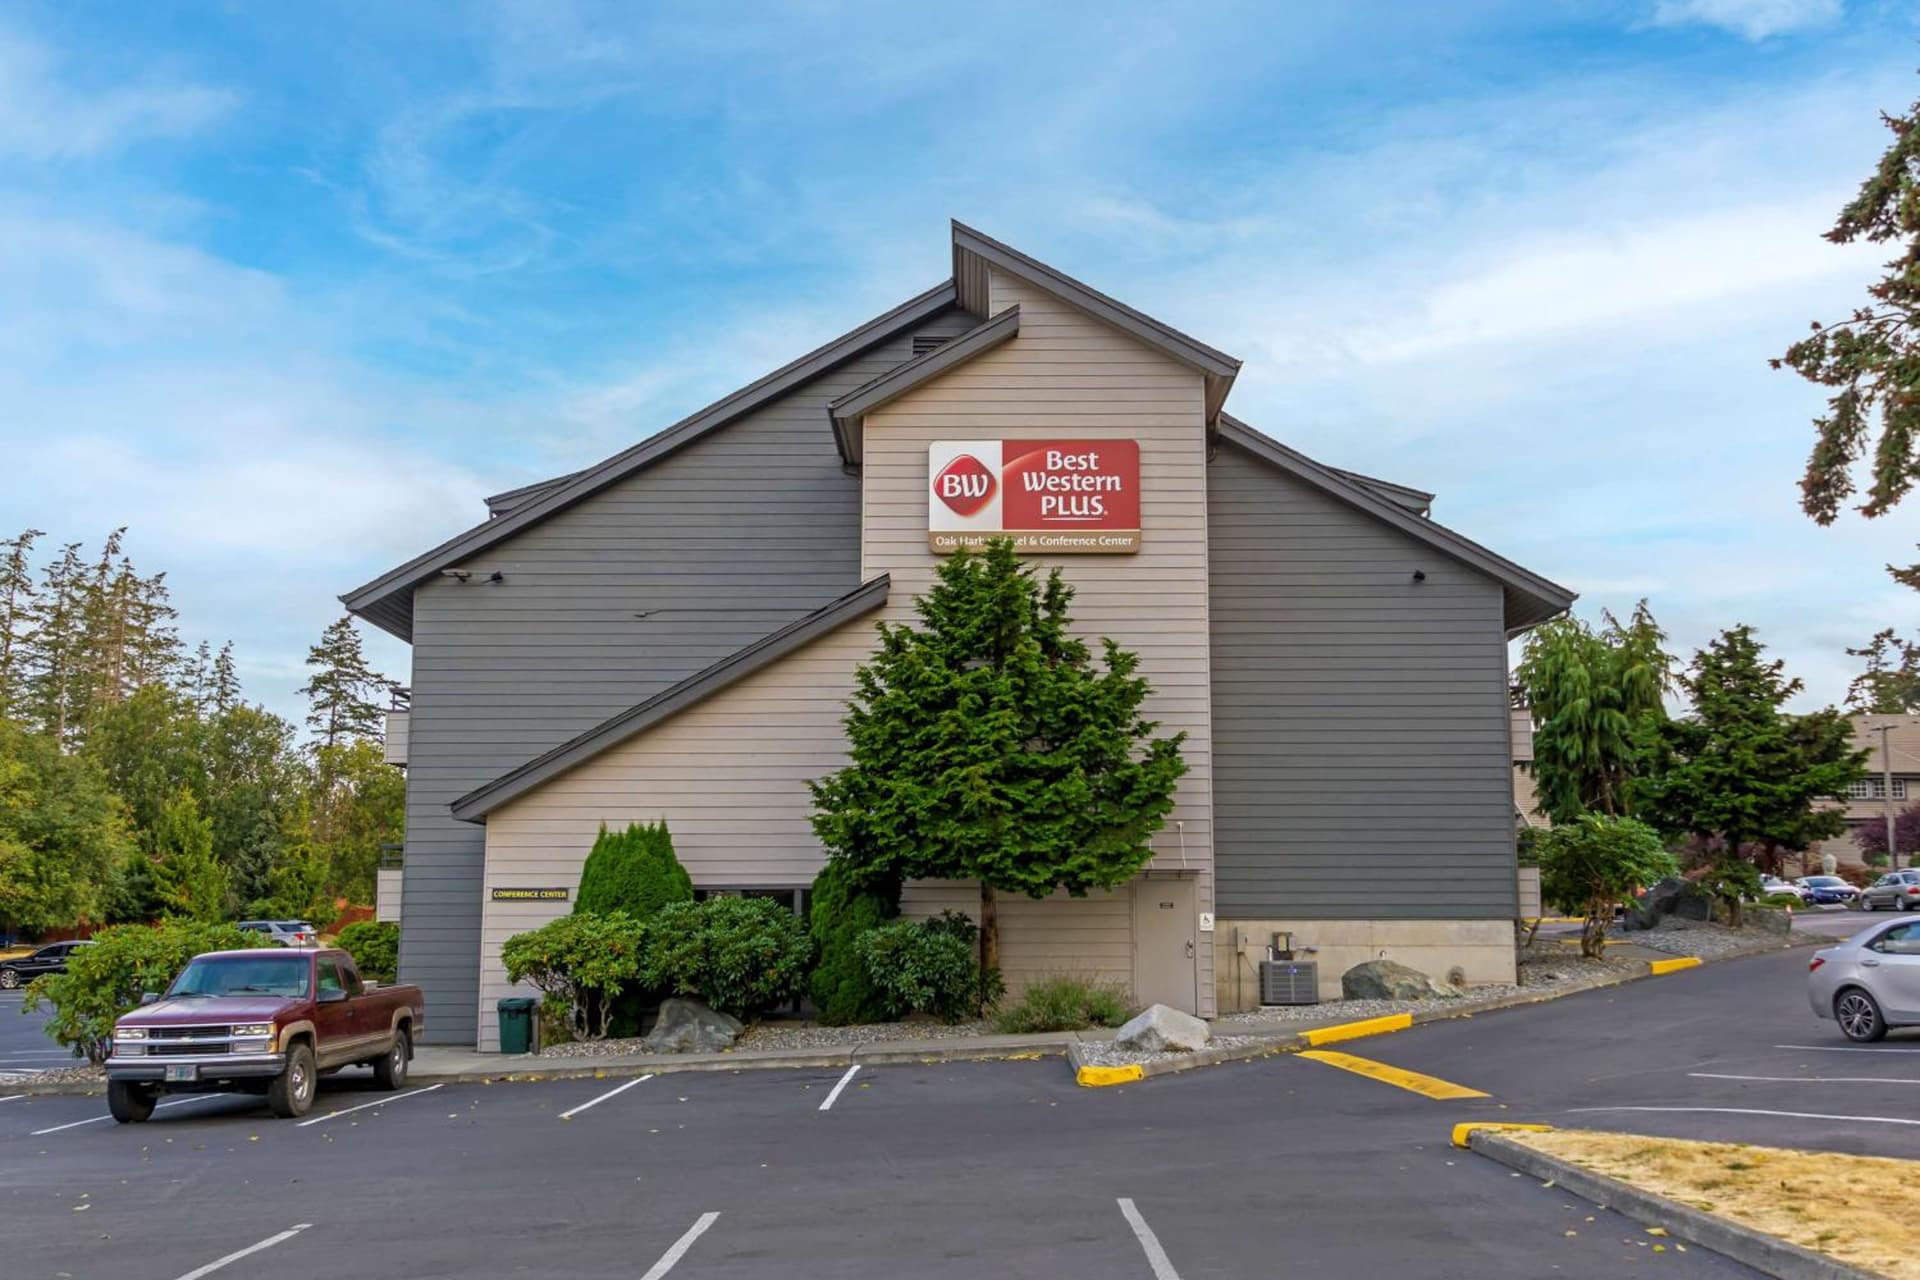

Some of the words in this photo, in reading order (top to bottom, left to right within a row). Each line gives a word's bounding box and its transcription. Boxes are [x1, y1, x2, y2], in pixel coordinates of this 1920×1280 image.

[1046, 450, 1099, 471] Best
[942, 474, 988, 498] BW
[1022, 472, 1122, 492] Western
[935, 535, 957, 546] Oak
[959, 535, 990, 546] Harb
[1029, 536, 1038, 546] &
[1039, 535, 1097, 546] Conference
[1098, 535, 1134, 546] Center
[493, 890, 539, 898] CONFERENCE
[540, 890, 567, 898] CENTER
